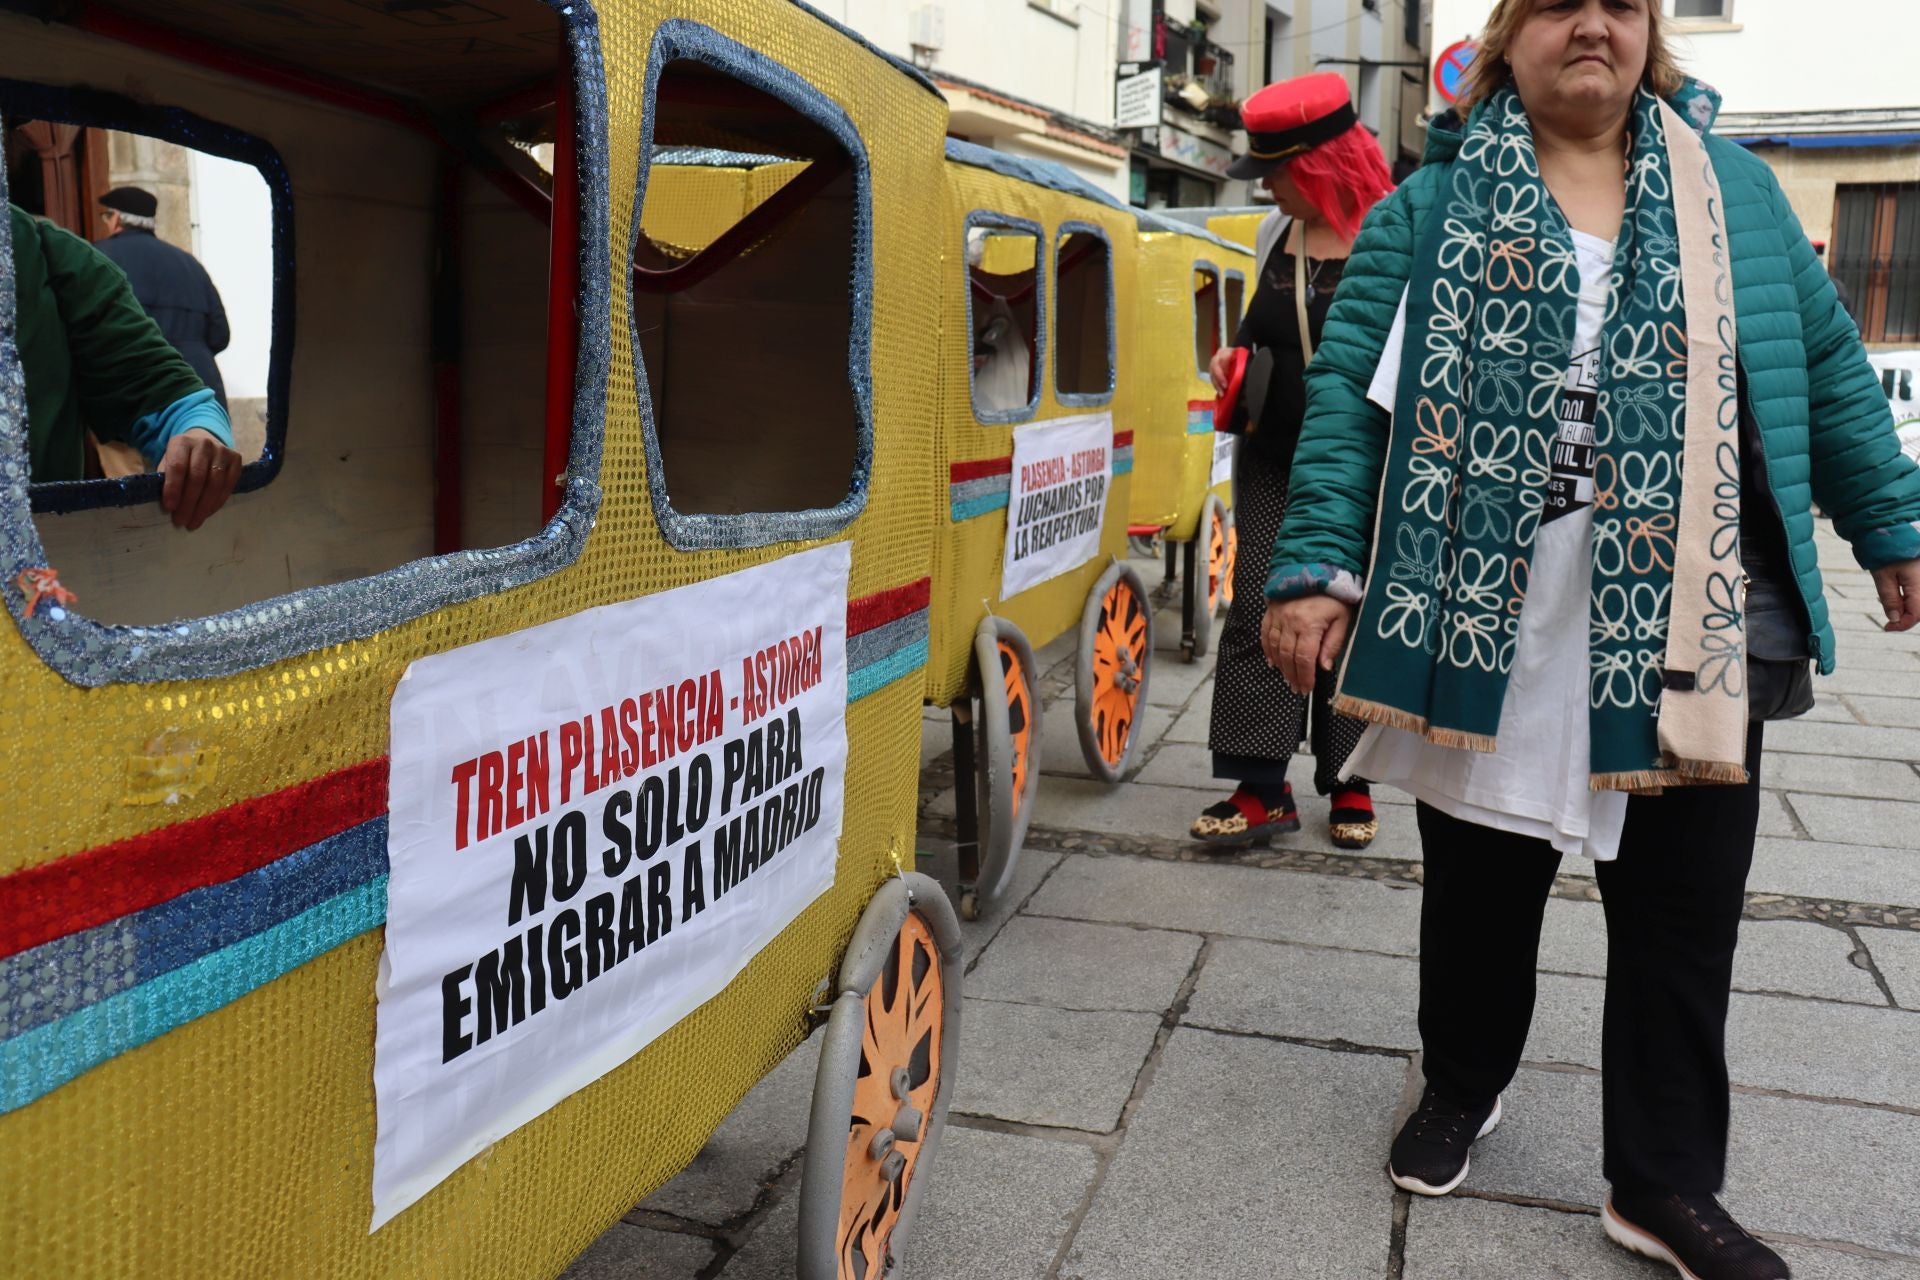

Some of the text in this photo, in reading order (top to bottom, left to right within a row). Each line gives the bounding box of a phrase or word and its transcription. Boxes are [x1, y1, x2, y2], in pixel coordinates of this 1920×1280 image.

[1014, 504, 1101, 562] LA REAPERTURA
[1017, 475, 1105, 528] LUCHAMOS POR
[1021, 456, 1066, 494] PLASENCIA
[1071, 447, 1105, 478] ASTORGA
[451, 729, 550, 852] TREN
[559, 669, 724, 806] PLASENCIA
[743, 625, 823, 727] ASTORGA
[508, 706, 803, 928] NO SOLO PARA
[441, 766, 825, 1065] EMIGRAR A MADRID
